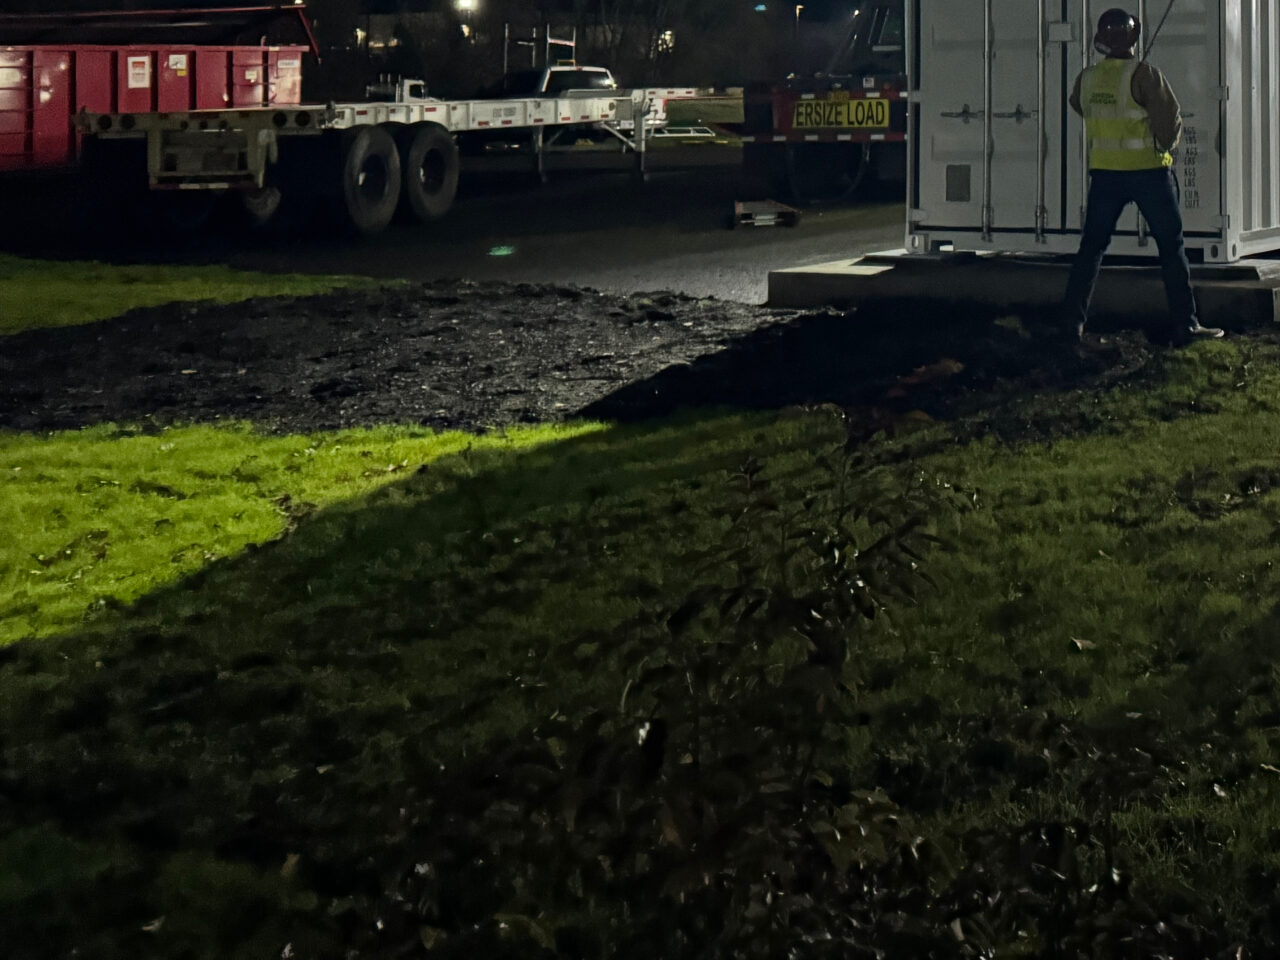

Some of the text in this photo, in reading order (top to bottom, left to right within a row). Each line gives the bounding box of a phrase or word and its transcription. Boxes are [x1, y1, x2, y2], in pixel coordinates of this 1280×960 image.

[796, 101, 885, 126] ERSIZE LOAD
[1184, 178, 1196, 187] LBS
